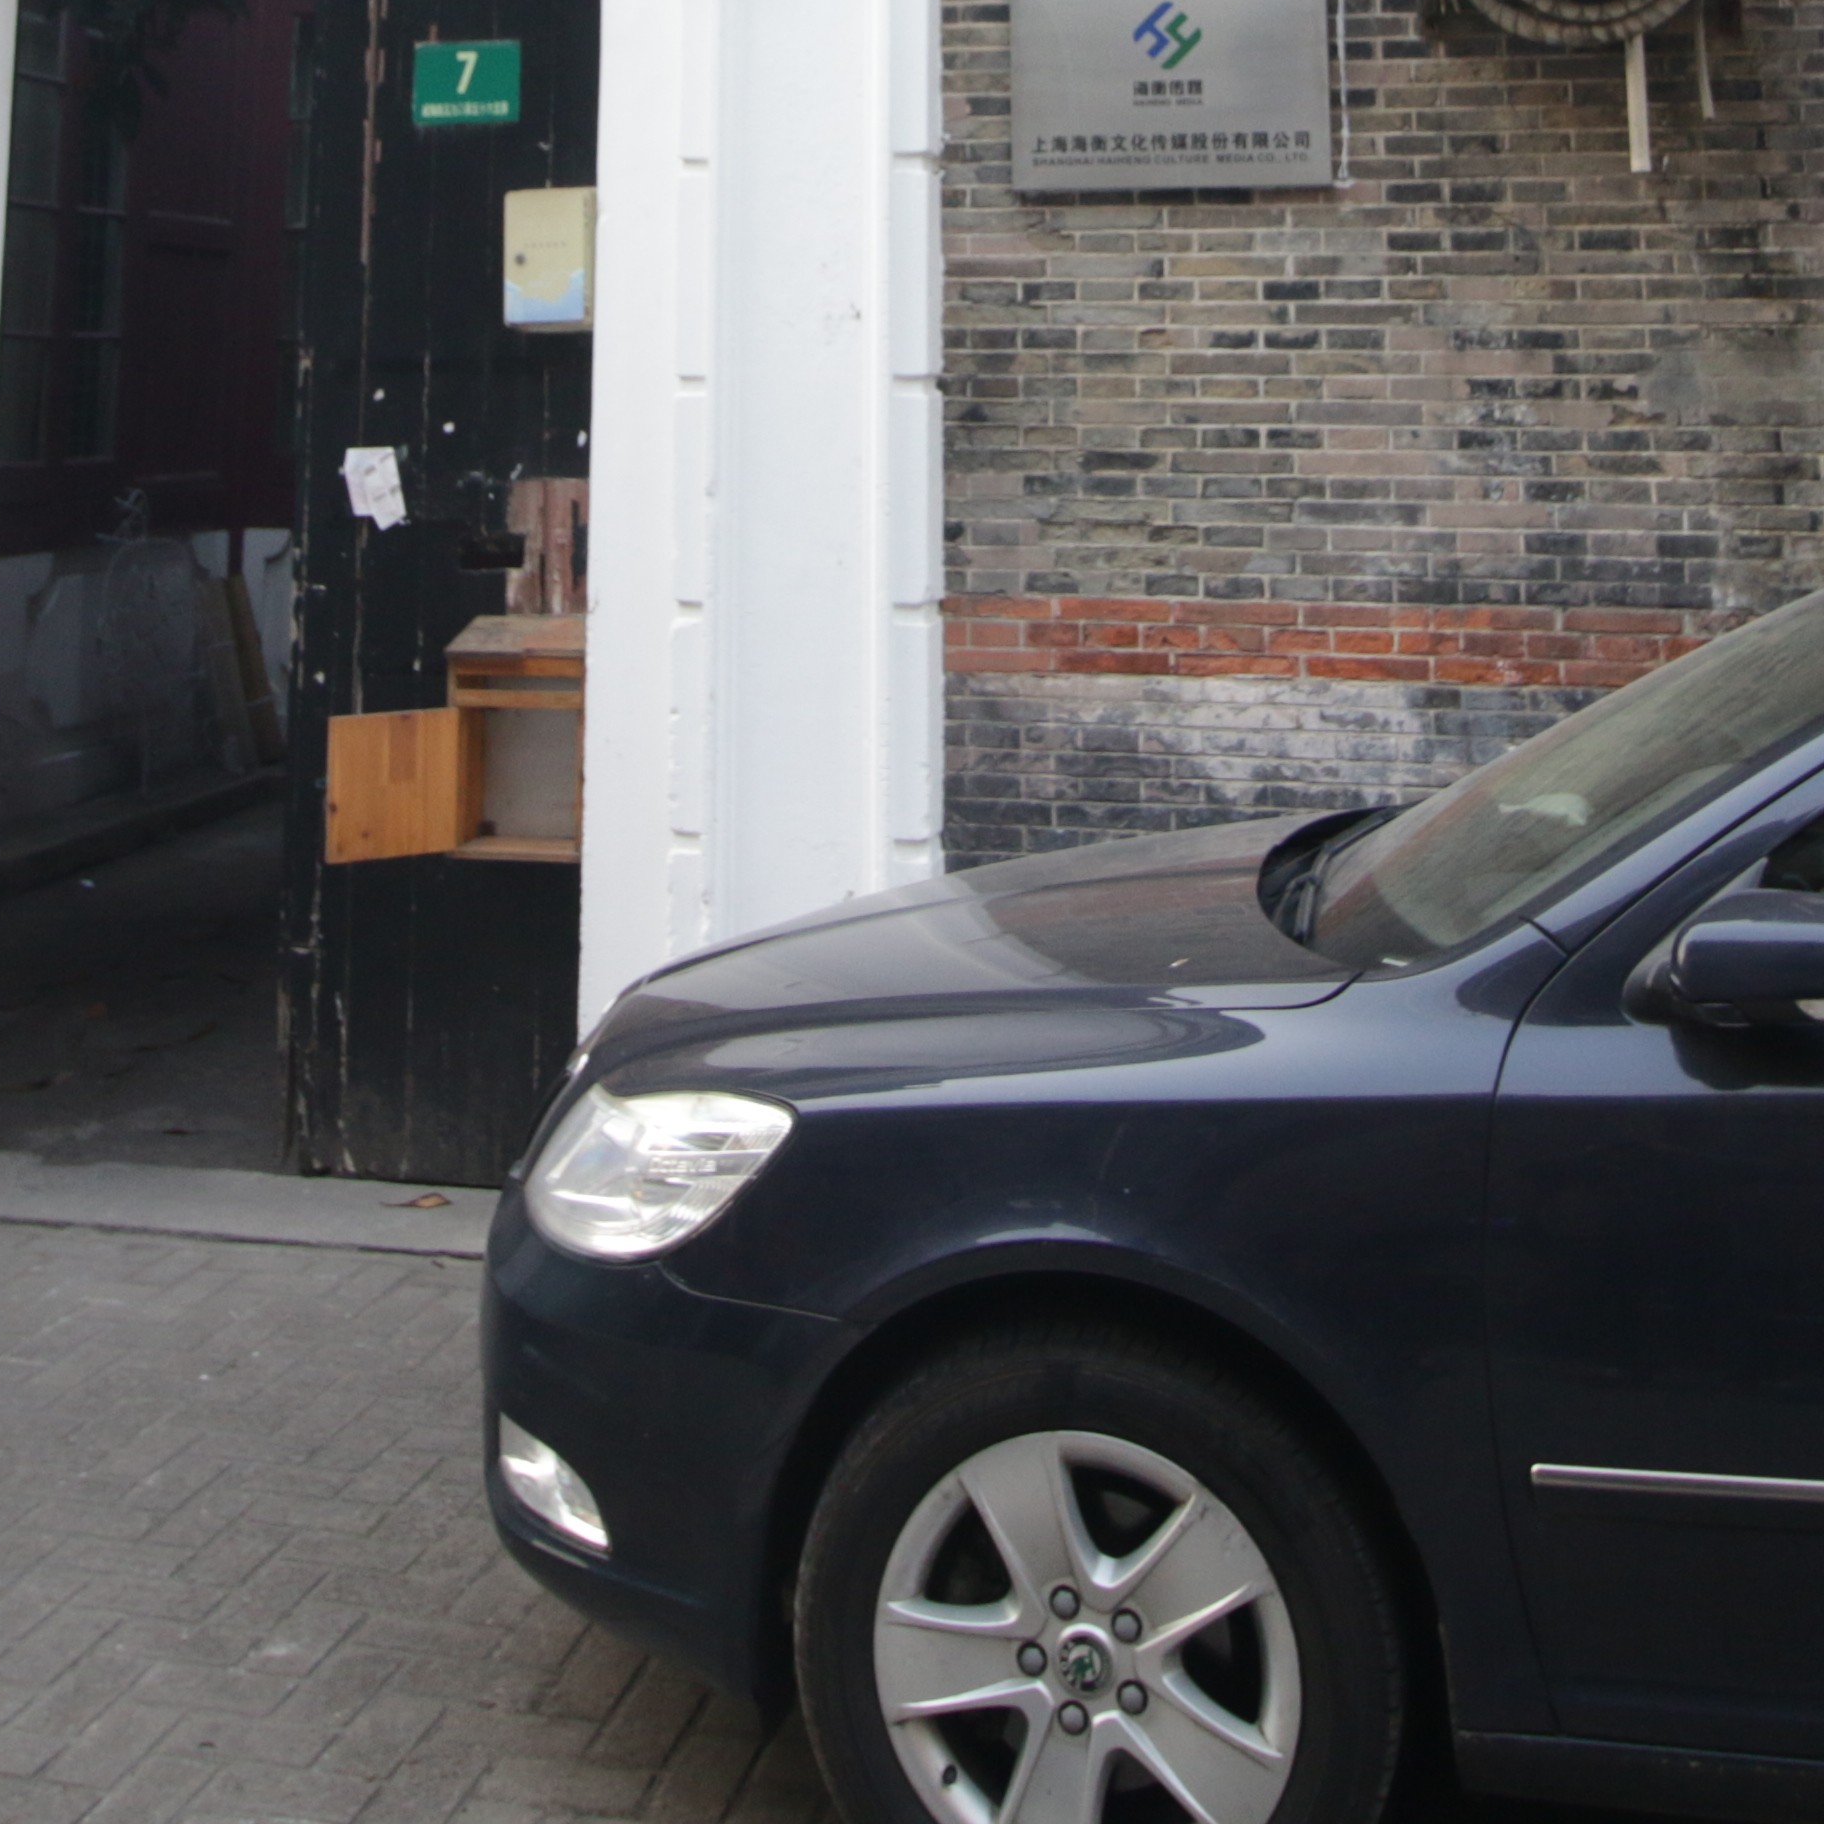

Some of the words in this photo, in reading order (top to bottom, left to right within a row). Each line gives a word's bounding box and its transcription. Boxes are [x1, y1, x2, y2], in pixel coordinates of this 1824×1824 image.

[455, 50, 479, 95] 7
[1031, 130, 1311, 154] 上海海衡文化传媒股份有限公司
[1154, 154, 1209, 164] CULTURE
[1216, 153, 1254, 163] MEDIA
